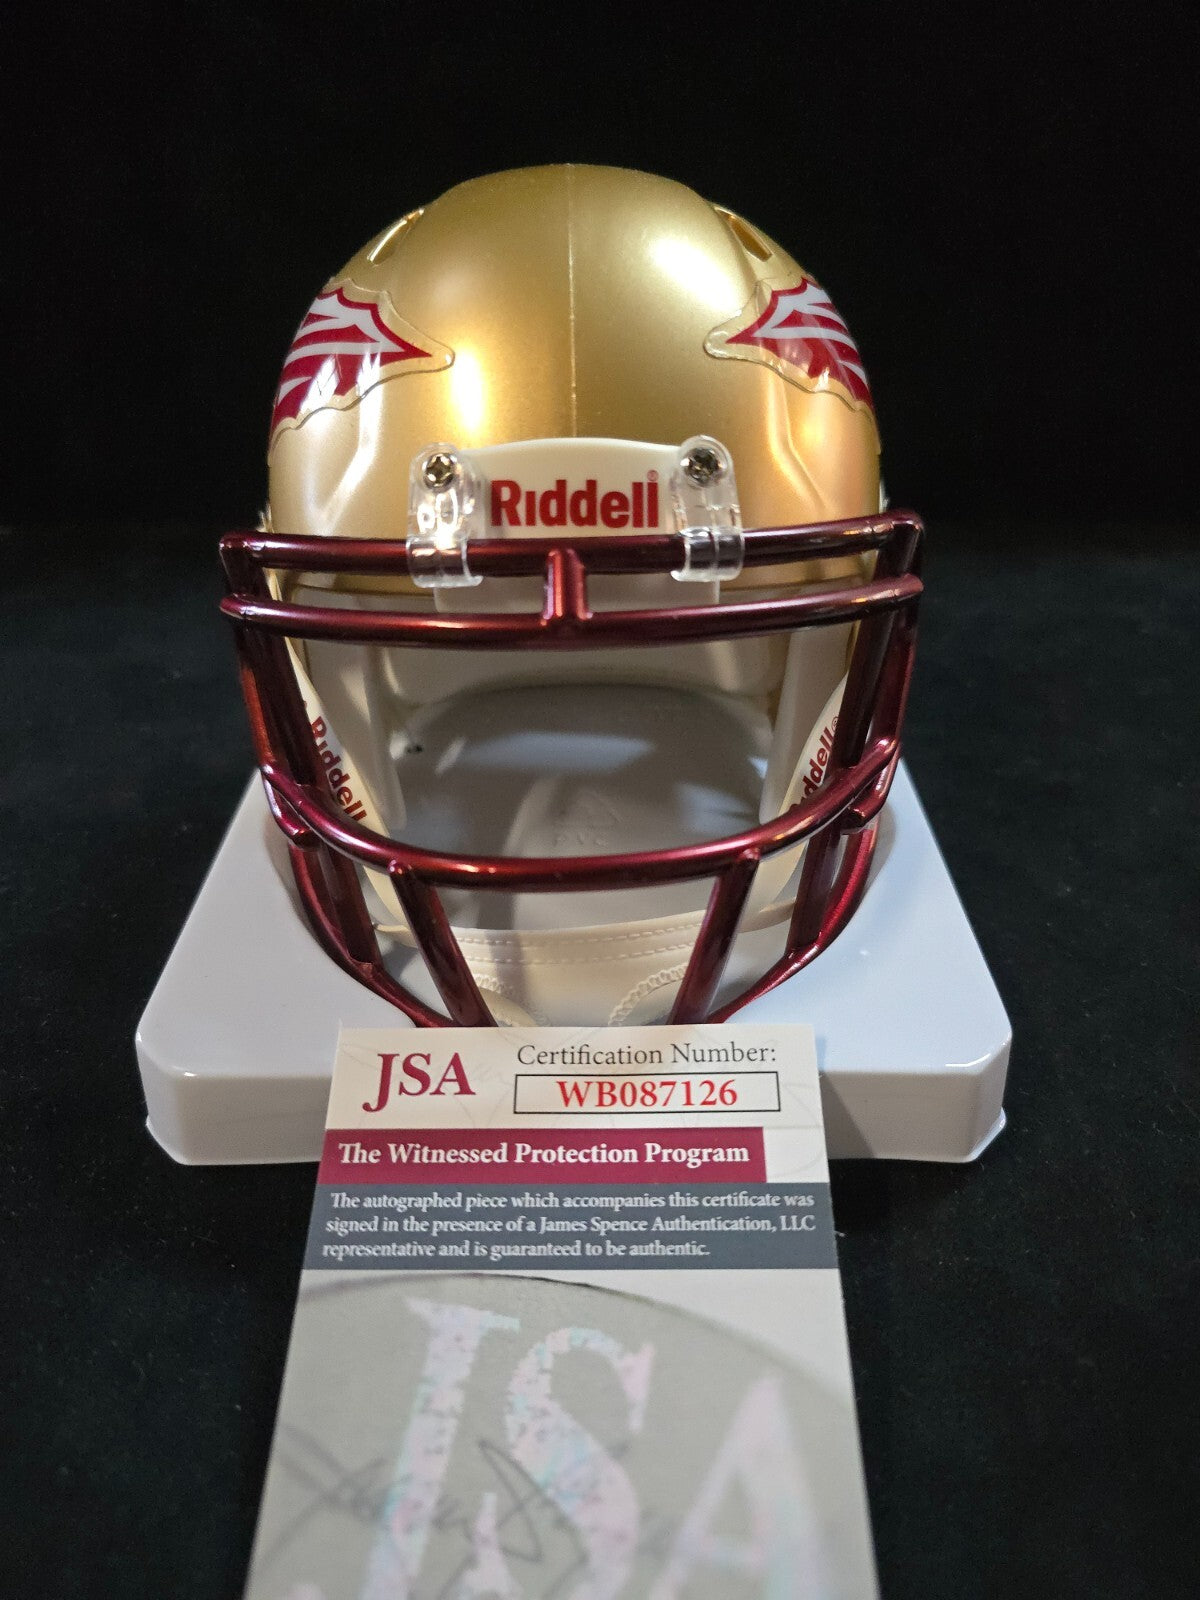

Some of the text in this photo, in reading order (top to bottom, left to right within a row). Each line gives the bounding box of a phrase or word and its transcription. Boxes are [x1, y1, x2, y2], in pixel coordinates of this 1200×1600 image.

[490, 479, 660, 528] Riddell
[517, 1041, 777, 1065] Certification Number:
[362, 1052, 477, 1113] JSA
[556, 1079, 738, 1108] WB087126
[338, 1142, 750, 1169] The Witnessed Protection Program
[331, 1191, 815, 1212] The autographed piece which accompanies this certificate was
[326, 1214, 816, 1237] signed in the presence of a James Spence Authentication, LLC
[322, 1239, 711, 1261] representative and is guaranteed to be authentic.
